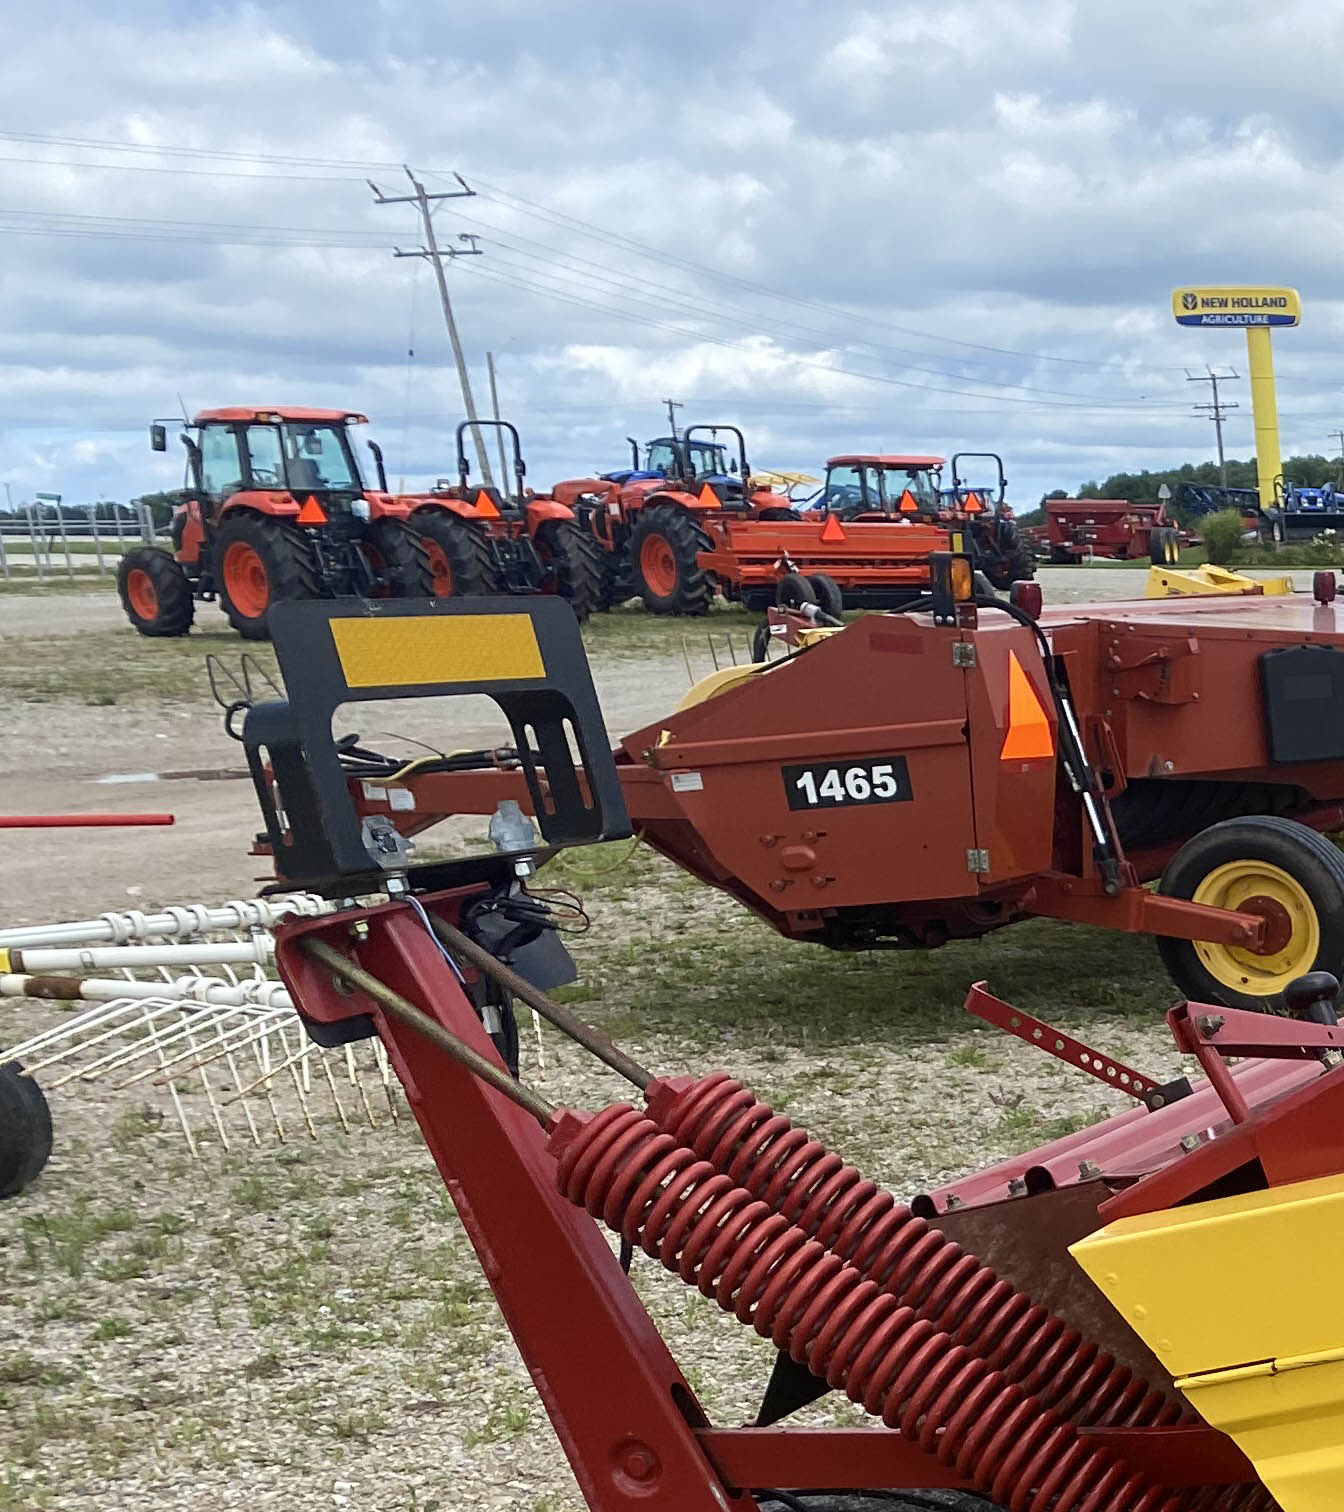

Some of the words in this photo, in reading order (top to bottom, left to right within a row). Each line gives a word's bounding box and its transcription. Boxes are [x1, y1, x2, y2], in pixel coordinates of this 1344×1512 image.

[1201, 297, 1228, 308] NEW
[1231, 296, 1287, 308] HOLLAND
[1201, 314, 1269, 324] AGRICULTURE
[796, 764, 897, 804] 1465
